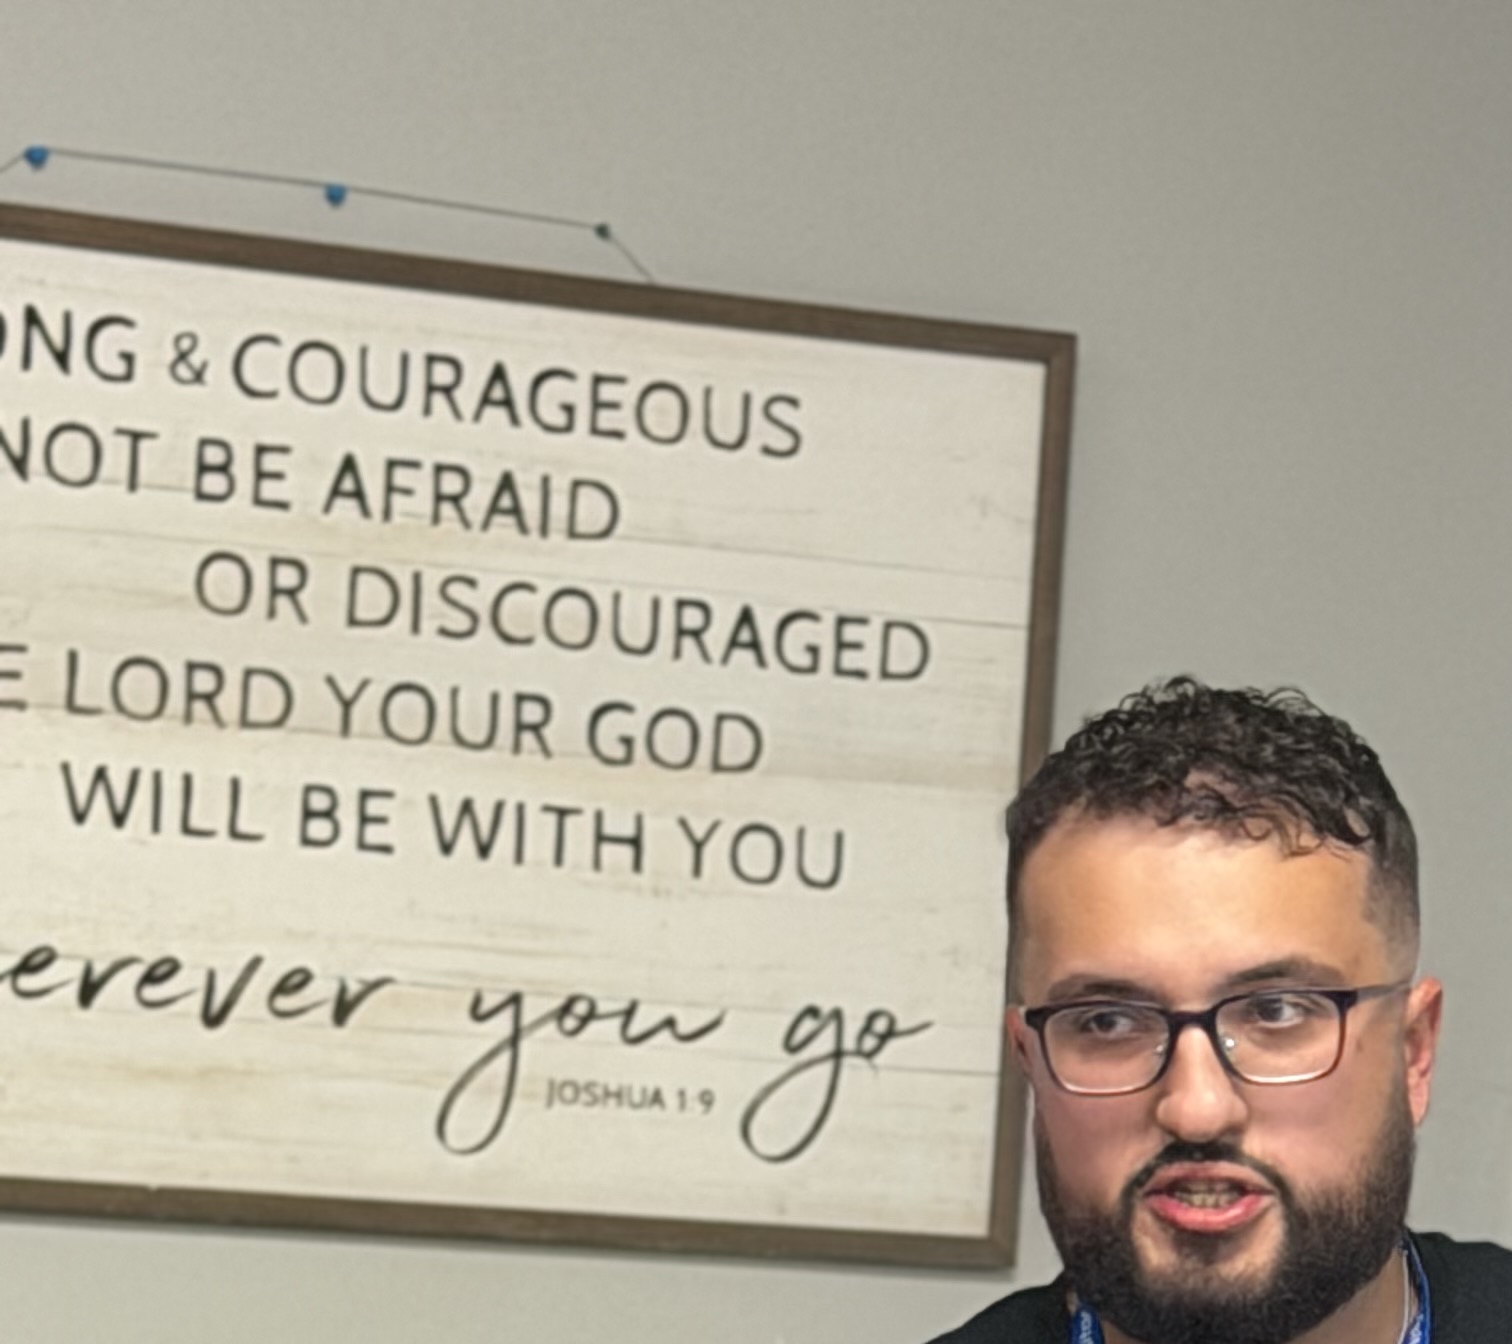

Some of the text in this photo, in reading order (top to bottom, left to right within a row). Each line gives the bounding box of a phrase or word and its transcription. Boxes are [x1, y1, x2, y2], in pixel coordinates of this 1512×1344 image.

[0, 303, 803, 459] NG & COURAGEOUS
[193, 437, 293, 512] BE
[322, 452, 621, 541] AFRAID
[194, 550, 931, 681] OR DISCOURAGED
[63, 648, 294, 730] LORD
[324, 674, 554, 760] YOUR
[586, 700, 764, 774] GOD
[60, 761, 845, 890] WILL BE WITH YOU
[435, 989, 726, 1155] you
[739, 1004, 934, 1164] go
[546, 1077, 667, 1111] JOSHUA
